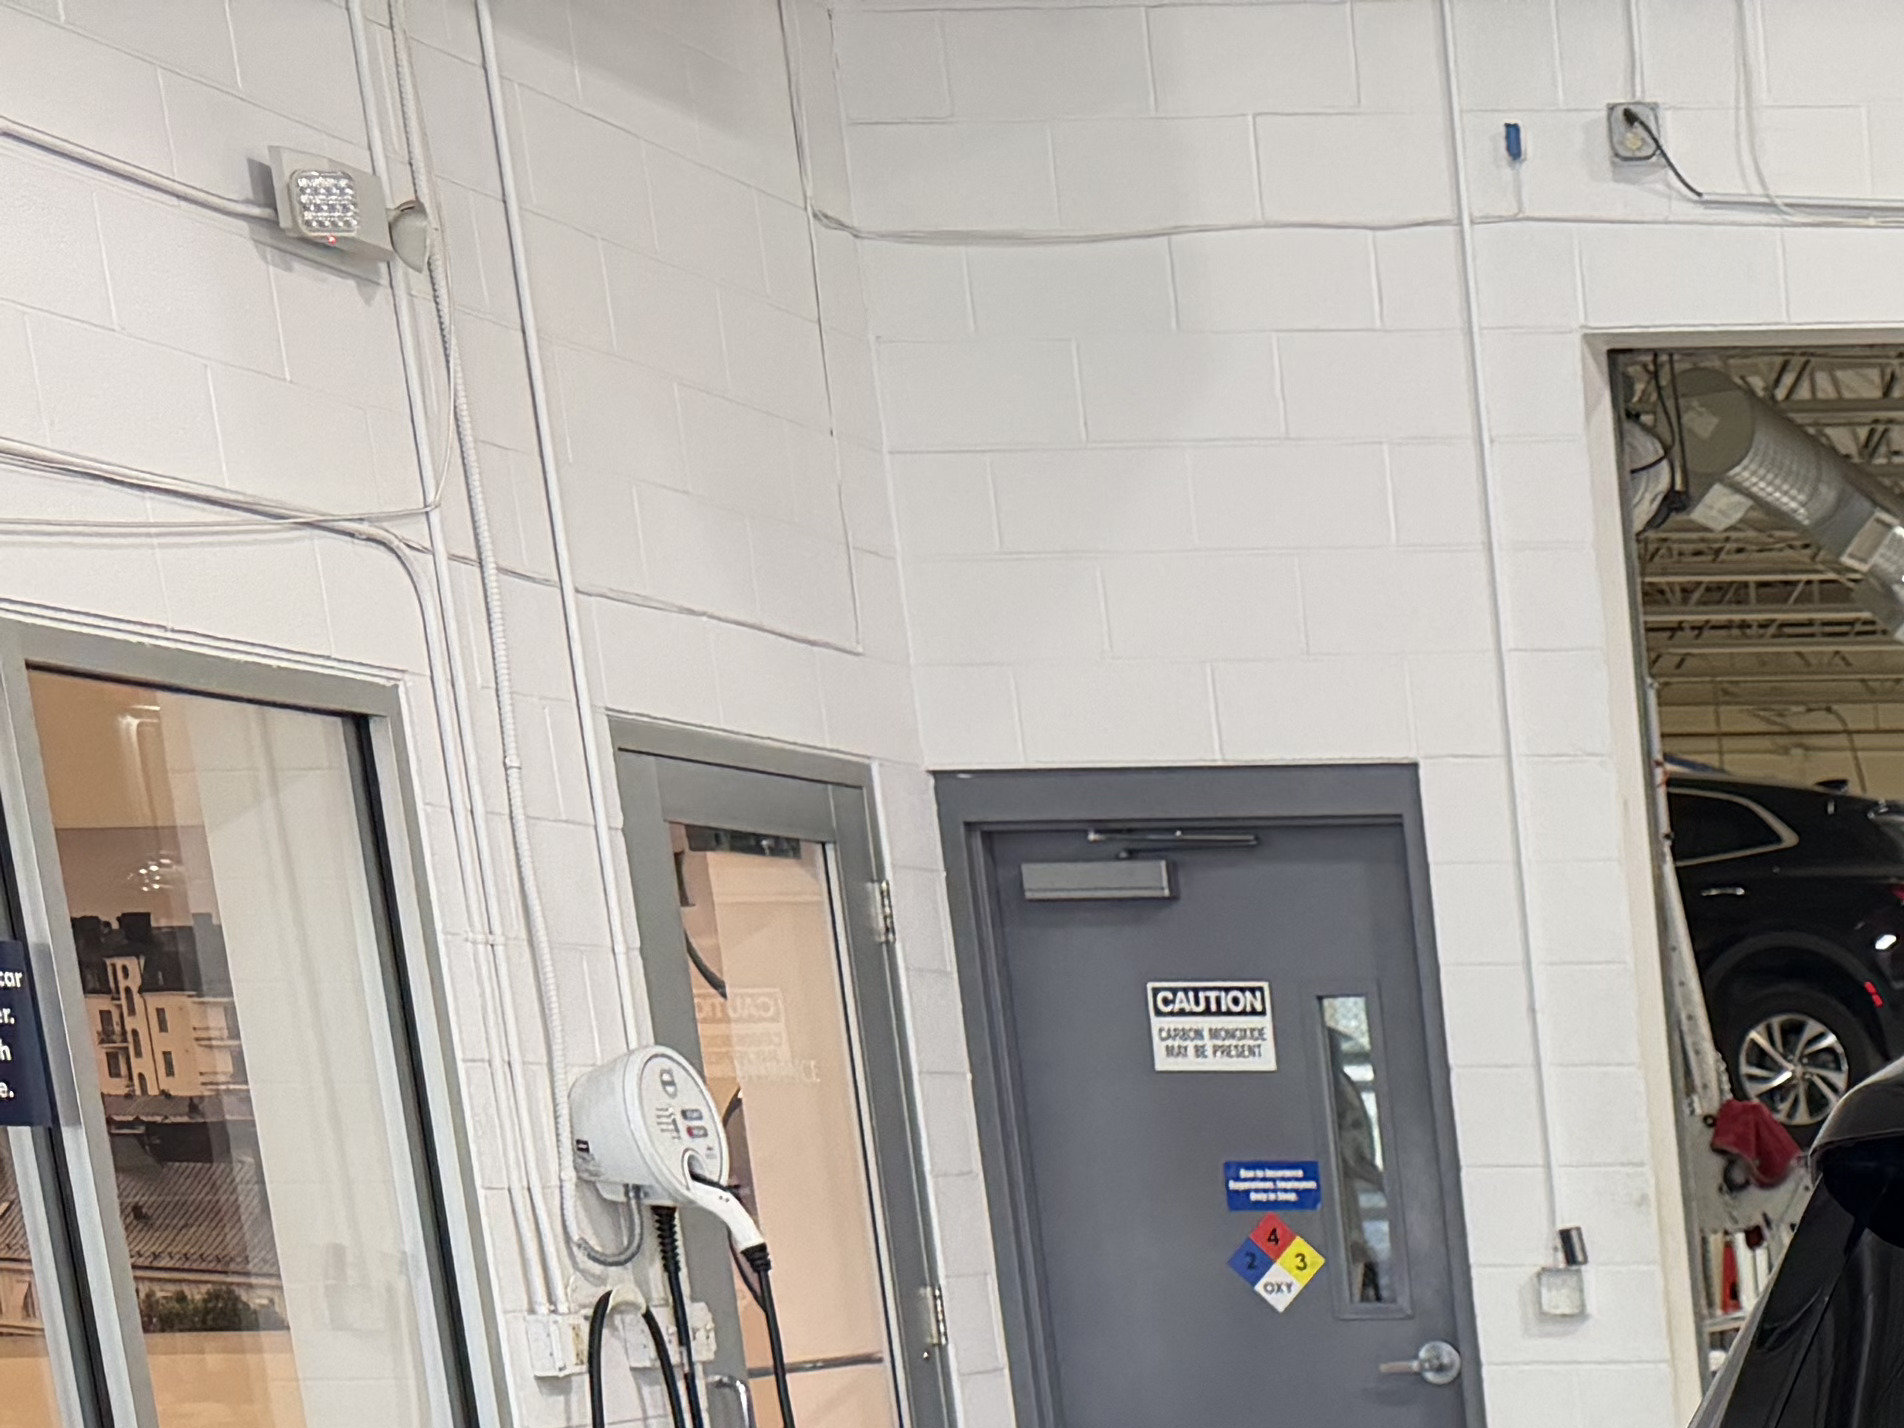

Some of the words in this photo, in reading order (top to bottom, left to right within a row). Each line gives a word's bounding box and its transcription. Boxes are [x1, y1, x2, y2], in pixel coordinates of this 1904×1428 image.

[1156, 990, 1263, 1013] CAUTION
[1158, 1026, 1204, 1041] CARBON
[1165, 1043, 1189, 1058] MAY
[1193, 1043, 1208, 1059] BE
[1212, 1043, 1262, 1058] PRESENT
[1267, 1227, 1279, 1246] 4
[1244, 1251, 1257, 1270] 2
[1294, 1252, 1308, 1272] 3
[1263, 1281, 1294, 1295] OXY
